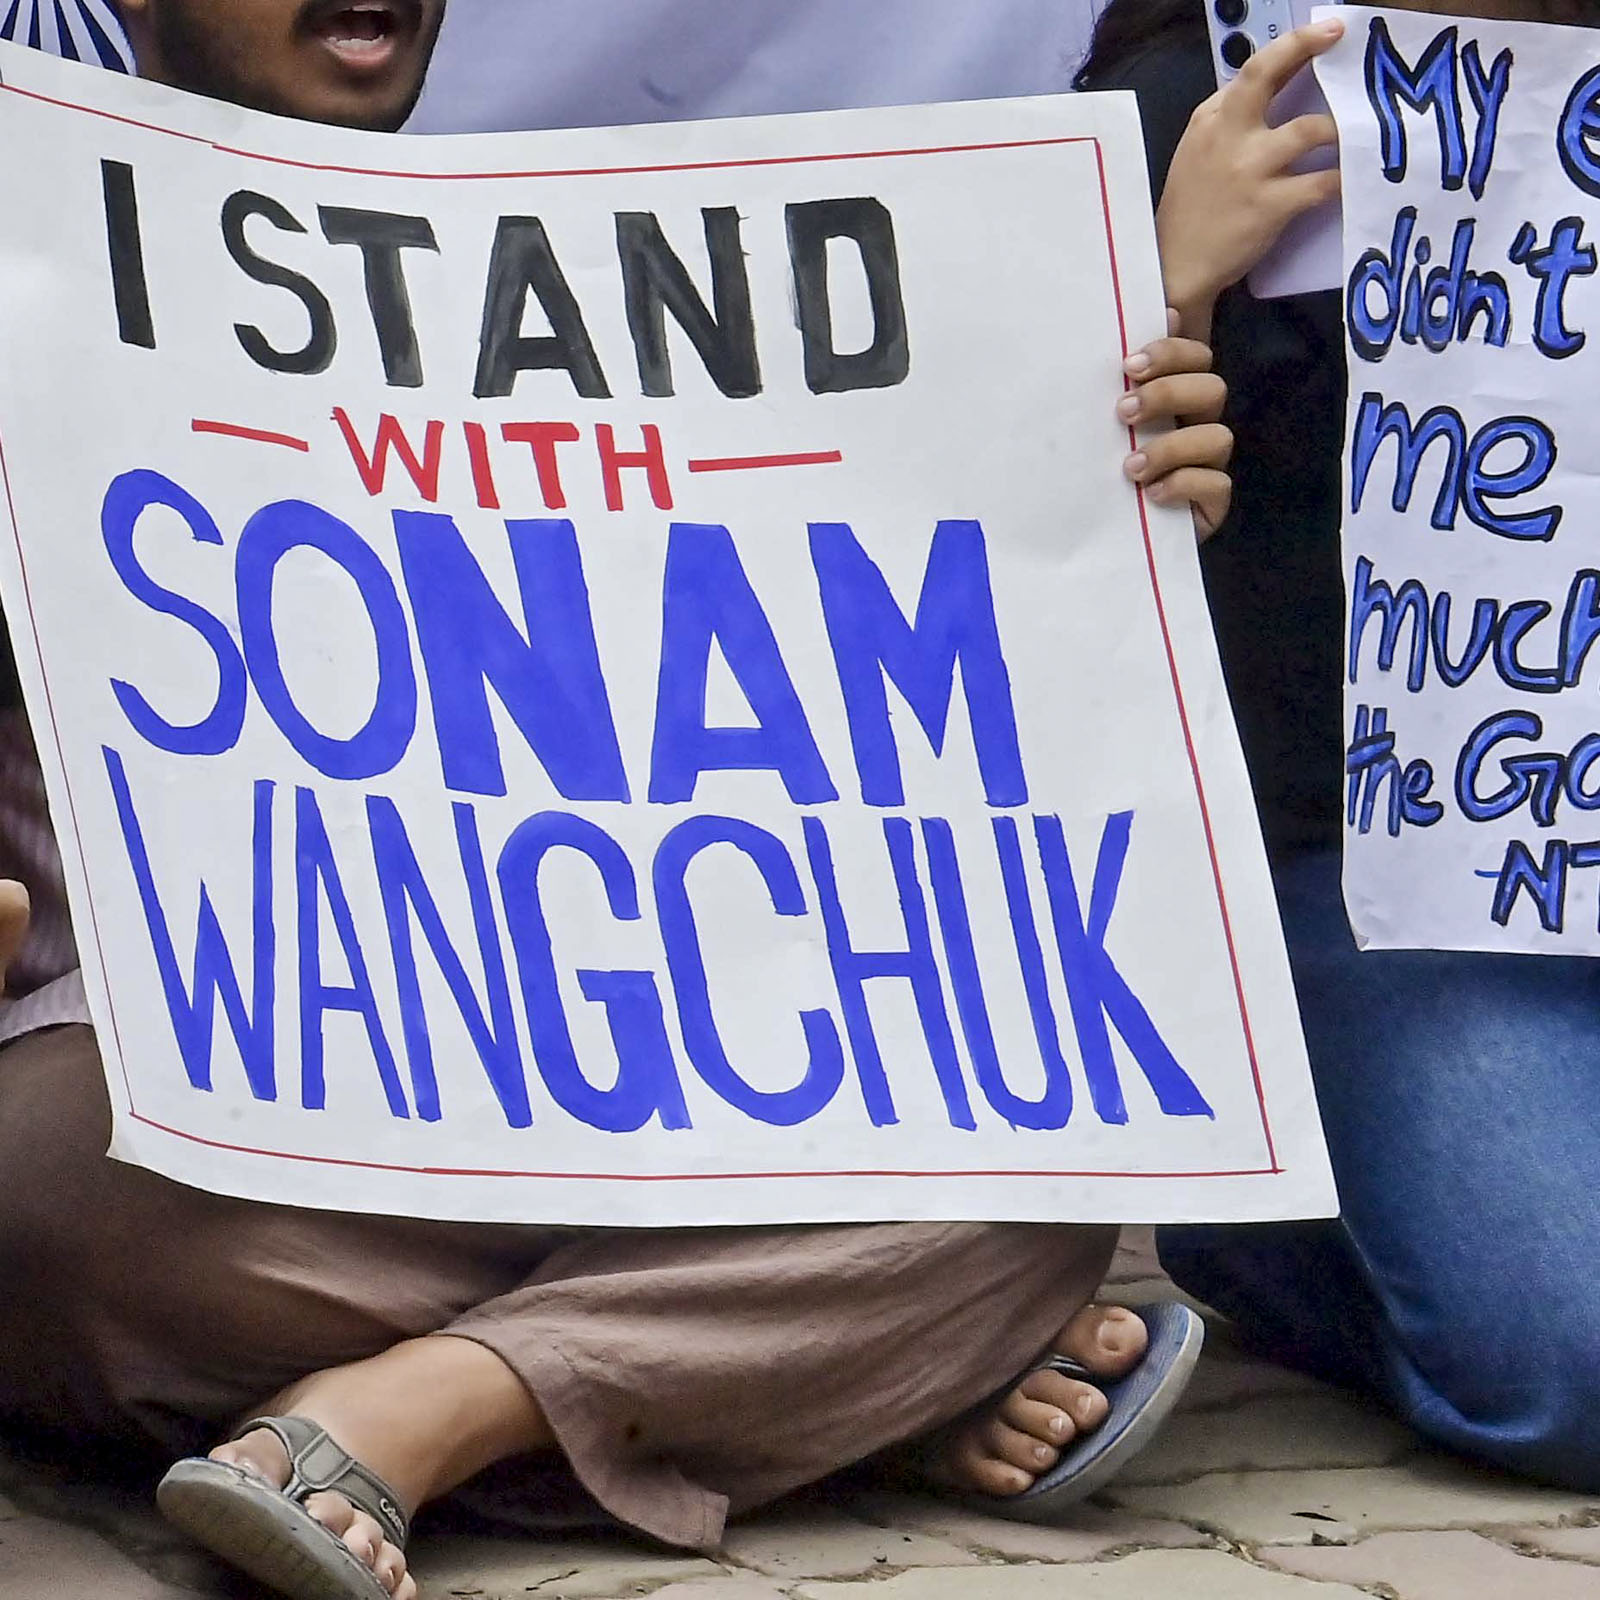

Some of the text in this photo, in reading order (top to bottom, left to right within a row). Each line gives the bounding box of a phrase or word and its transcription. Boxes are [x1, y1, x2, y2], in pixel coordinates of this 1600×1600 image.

[99, 159, 911, 400] I STAND
[1347, 205, 1598, 363] didn't
[330, 404, 674, 513] WITH
[1351, 391, 1564, 543] me
[100, 468, 1029, 810] SONAM
[1347, 703, 1445, 838] the
[102, 743, 1216, 1134] WANGCHUK
